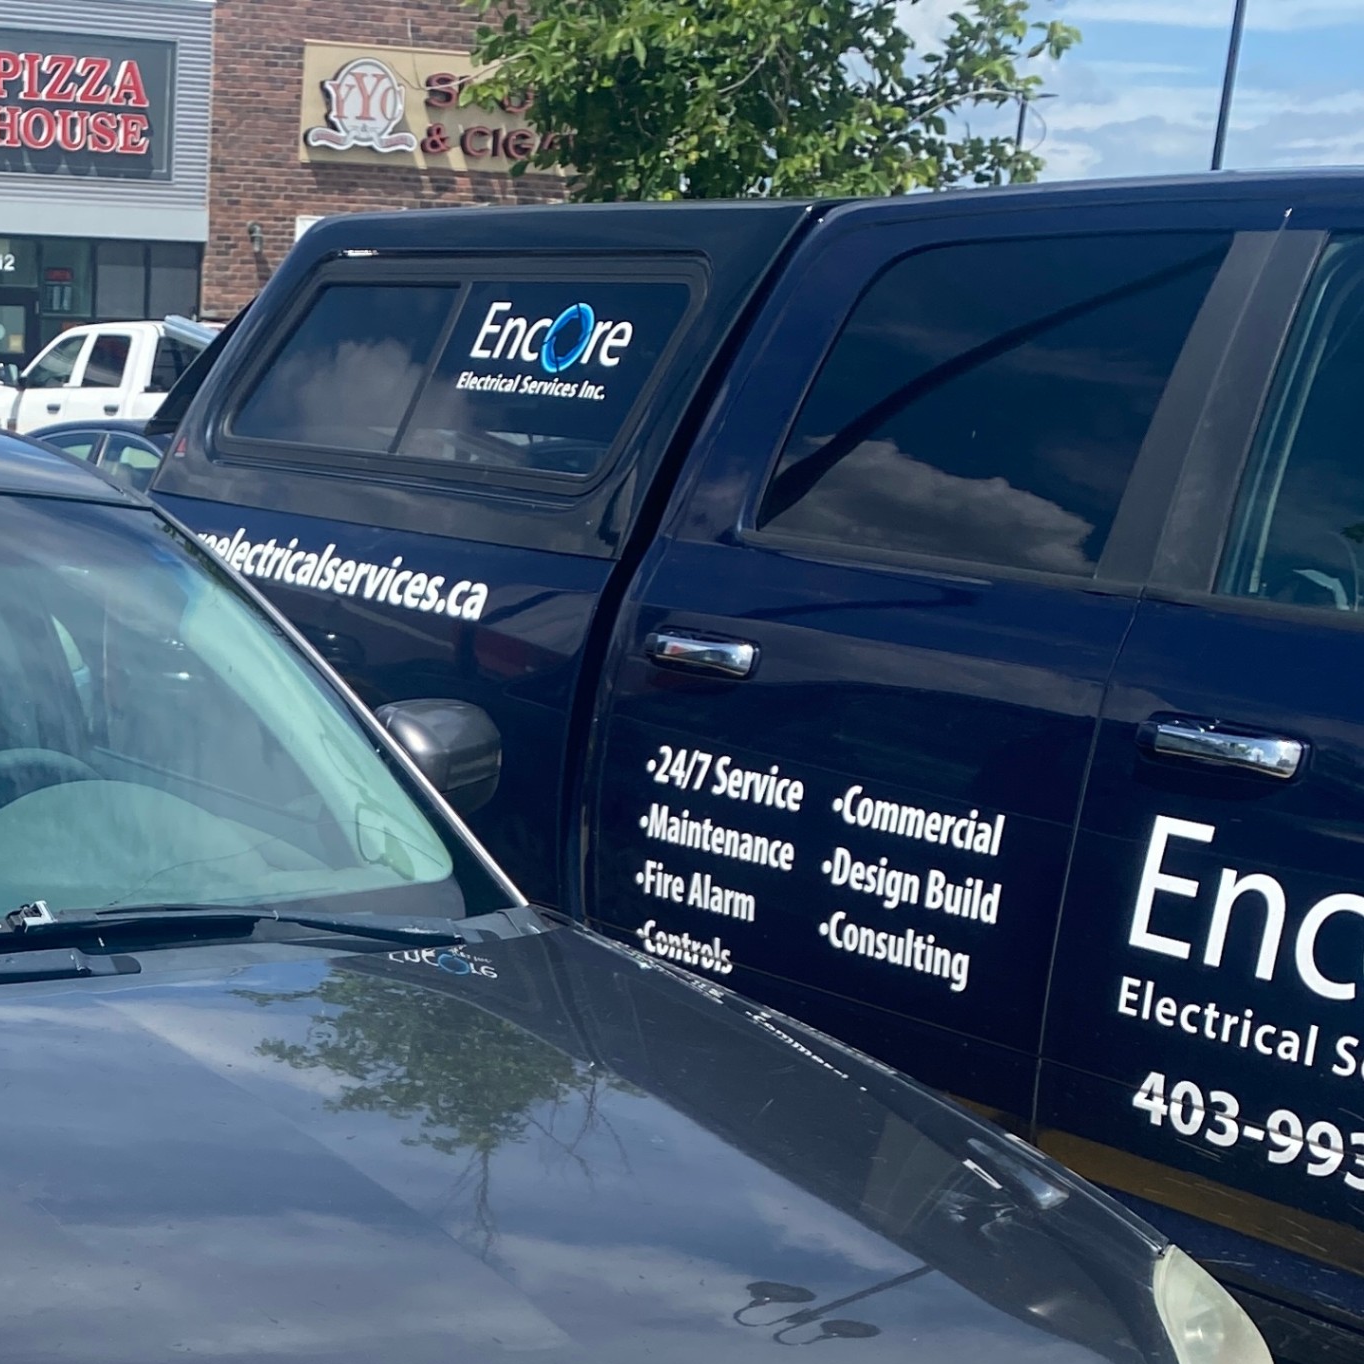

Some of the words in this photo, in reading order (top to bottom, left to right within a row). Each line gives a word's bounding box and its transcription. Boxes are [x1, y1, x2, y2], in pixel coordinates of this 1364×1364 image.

[455, 371, 523, 393] Electrical
[518, 375, 579, 398] Services
[578, 380, 606, 401] Inc.
[653, 745, 713, 792] 24/7
[711, 755, 804, 813] Service
[646, 802, 795, 872] Maintenance
[841, 784, 1006, 857] Commercial
[643, 859, 685, 903] Fire
[687, 871, 756, 923] Alarm
[830, 846, 921, 910] Design
[924, 869, 1002, 925] Build
[642, 919, 734, 976] Controls
[828, 911, 971, 993] Consulting
[1117, 975, 1320, 1067] Electrical
[1331, 1034, 1364, 1078] S
